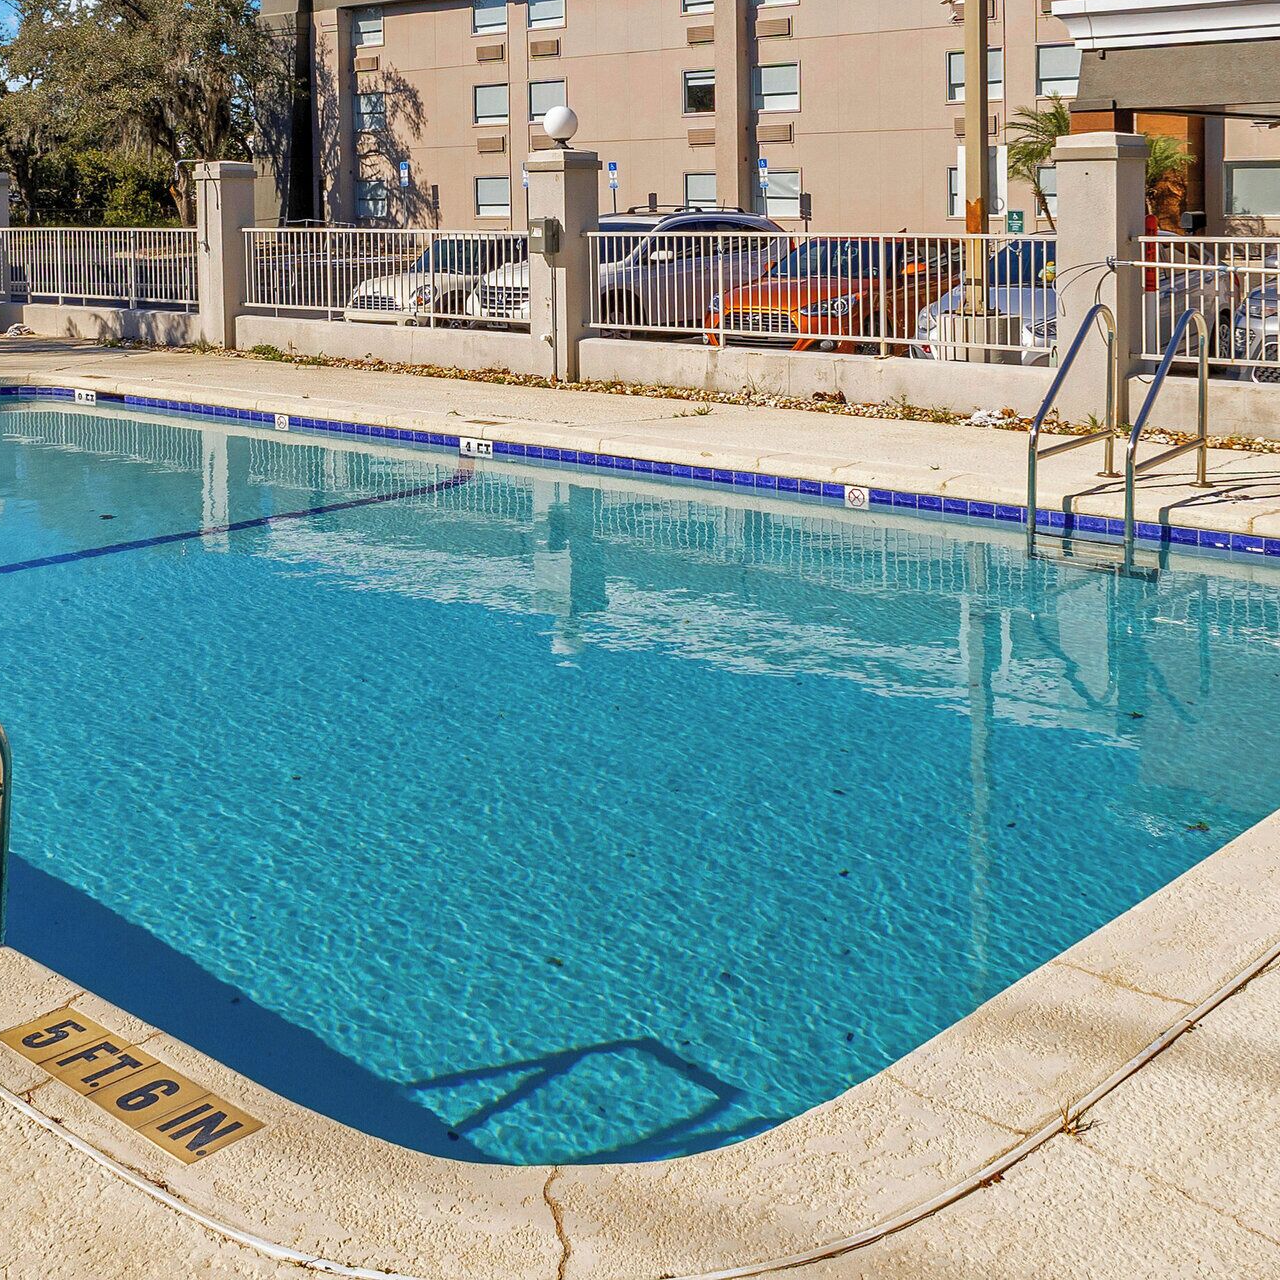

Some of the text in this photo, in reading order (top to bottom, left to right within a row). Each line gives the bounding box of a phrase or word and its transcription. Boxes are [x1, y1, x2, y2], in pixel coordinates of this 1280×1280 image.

[21, 1019, 245, 1157] 5 FT. 6 IN.
